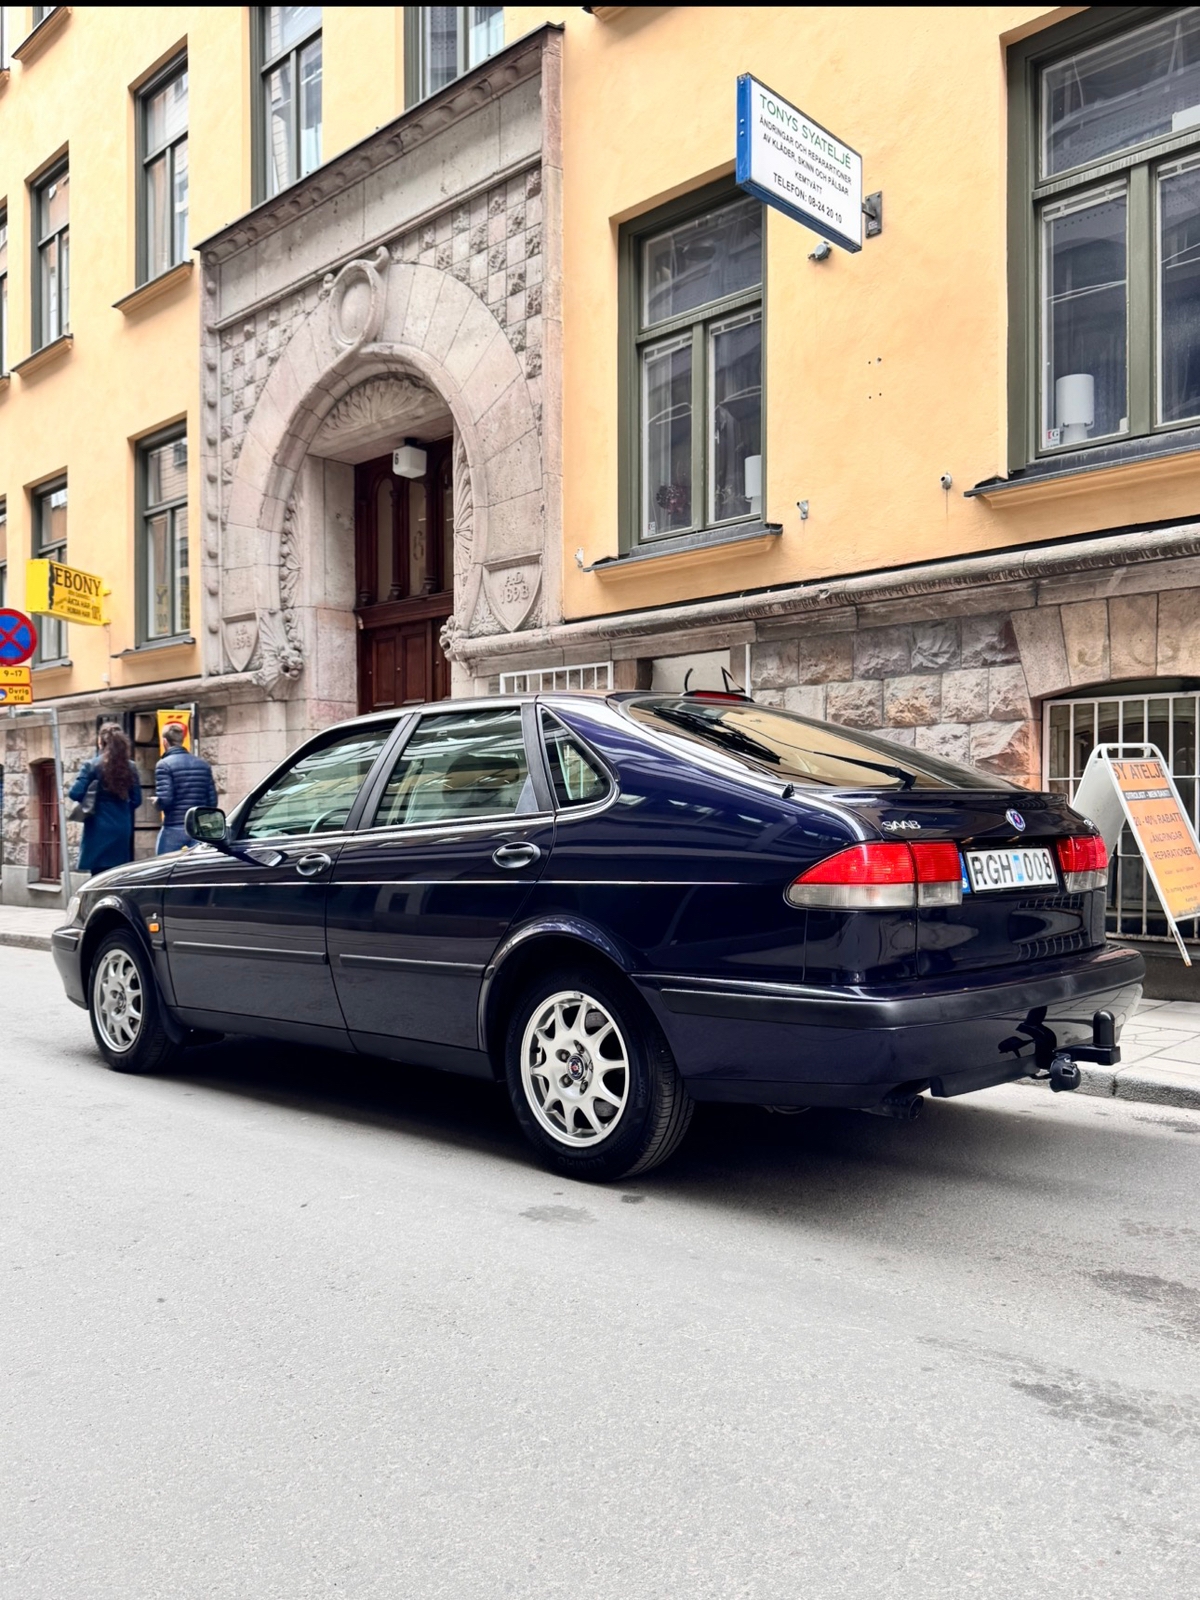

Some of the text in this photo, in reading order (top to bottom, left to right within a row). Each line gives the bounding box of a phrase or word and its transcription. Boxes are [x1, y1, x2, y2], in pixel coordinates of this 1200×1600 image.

[759, 93, 851, 169] TONYS SYATELJÉ
[759, 114, 794, 146] ÄNDRINGAR
[795, 140, 808, 155] OCH
[763, 132, 771, 144] AV
[771, 138, 797, 162] KLÄDER,
[798, 155, 815, 173] SKINN
[815, 168, 827, 182] OCH
[773, 171, 843, 224] TELEFON: 08-24 20 10
[794, 170, 823, 194] KEMTVÄTT
[394, 452, 399, 465] 6
[413, 530, 424, 560] 6
[54, 566, 101, 597] EBONY
[8, 687, 29, 695] Övrig
[881, 820, 921, 831] SAAB
[970, 852, 1053, 886] RGH 008
